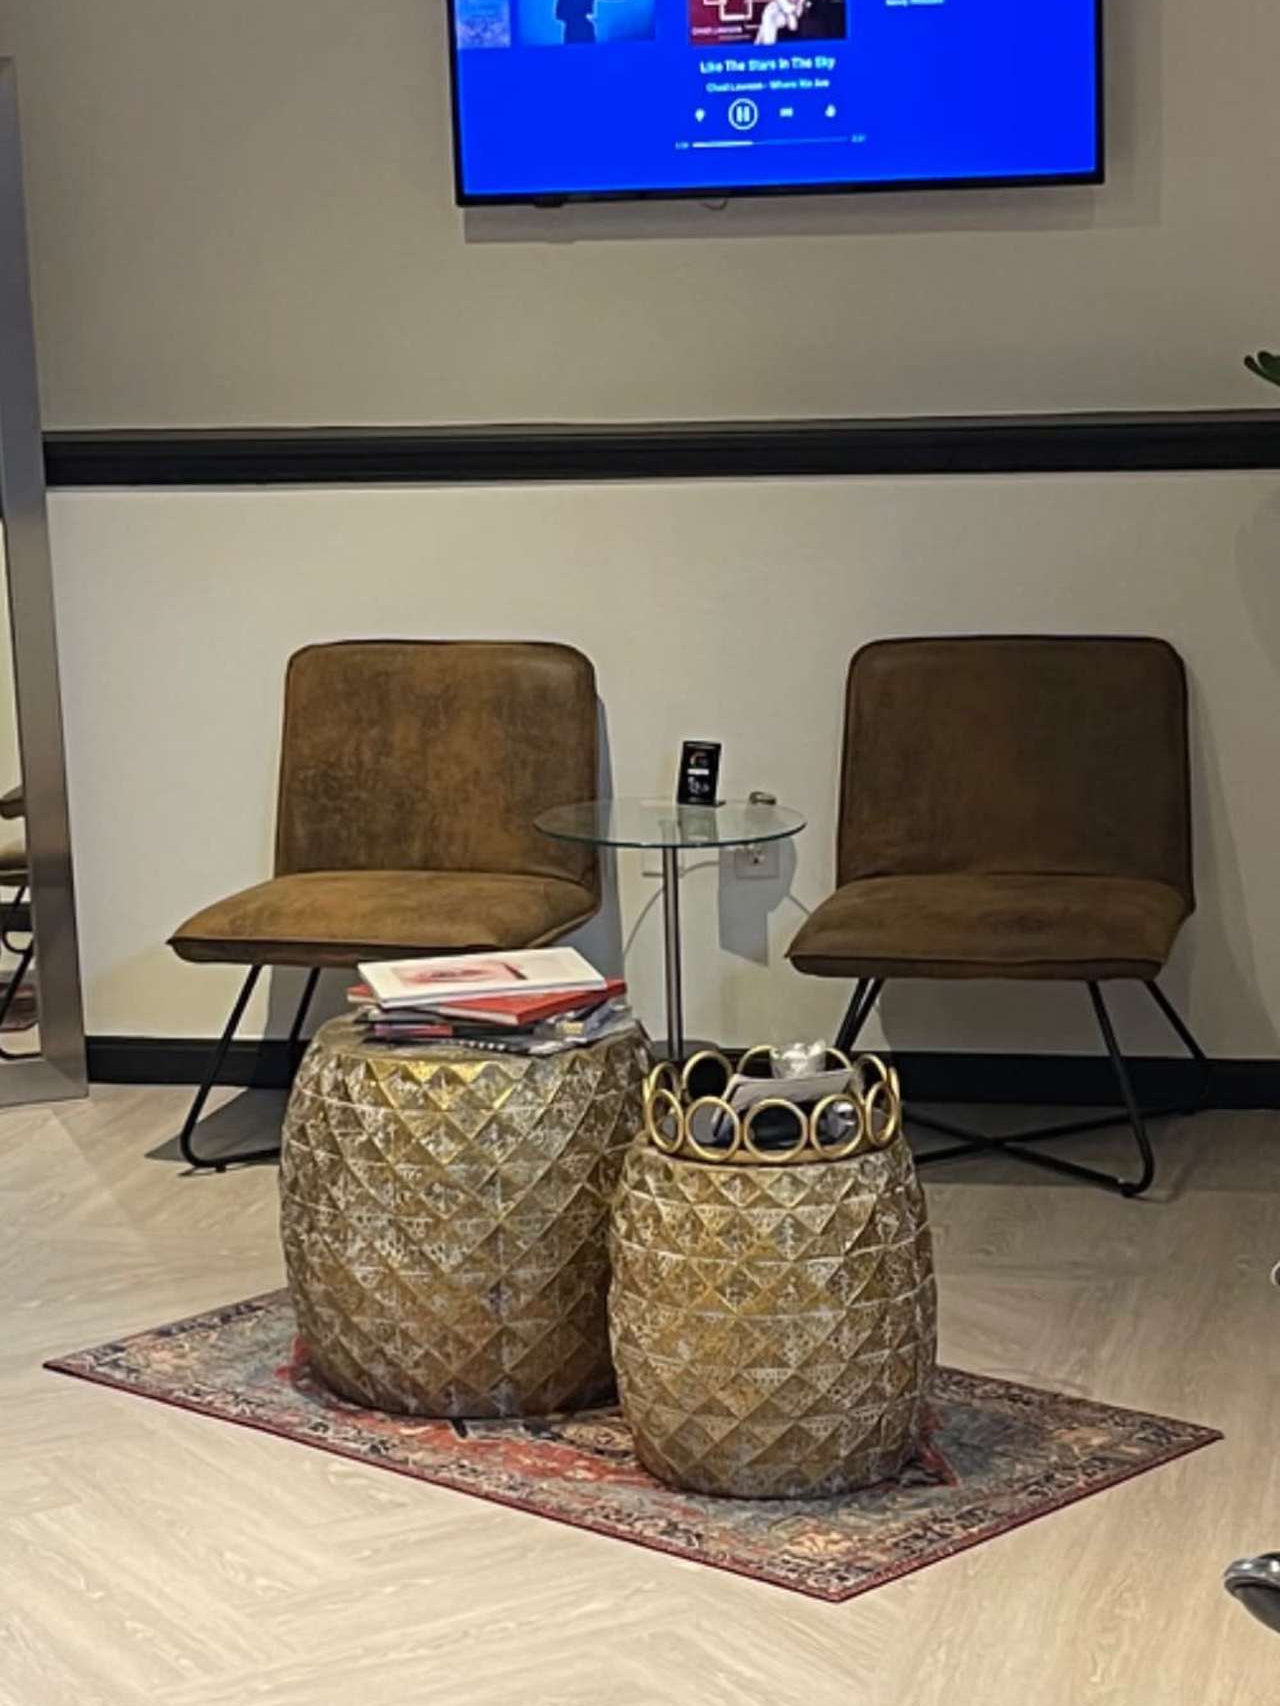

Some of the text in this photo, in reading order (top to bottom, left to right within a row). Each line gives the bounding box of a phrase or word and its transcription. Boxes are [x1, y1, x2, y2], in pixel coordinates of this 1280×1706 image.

[700, 60, 723, 74] Like
[725, 58, 745, 73] The
[791, 56, 812, 70] The
